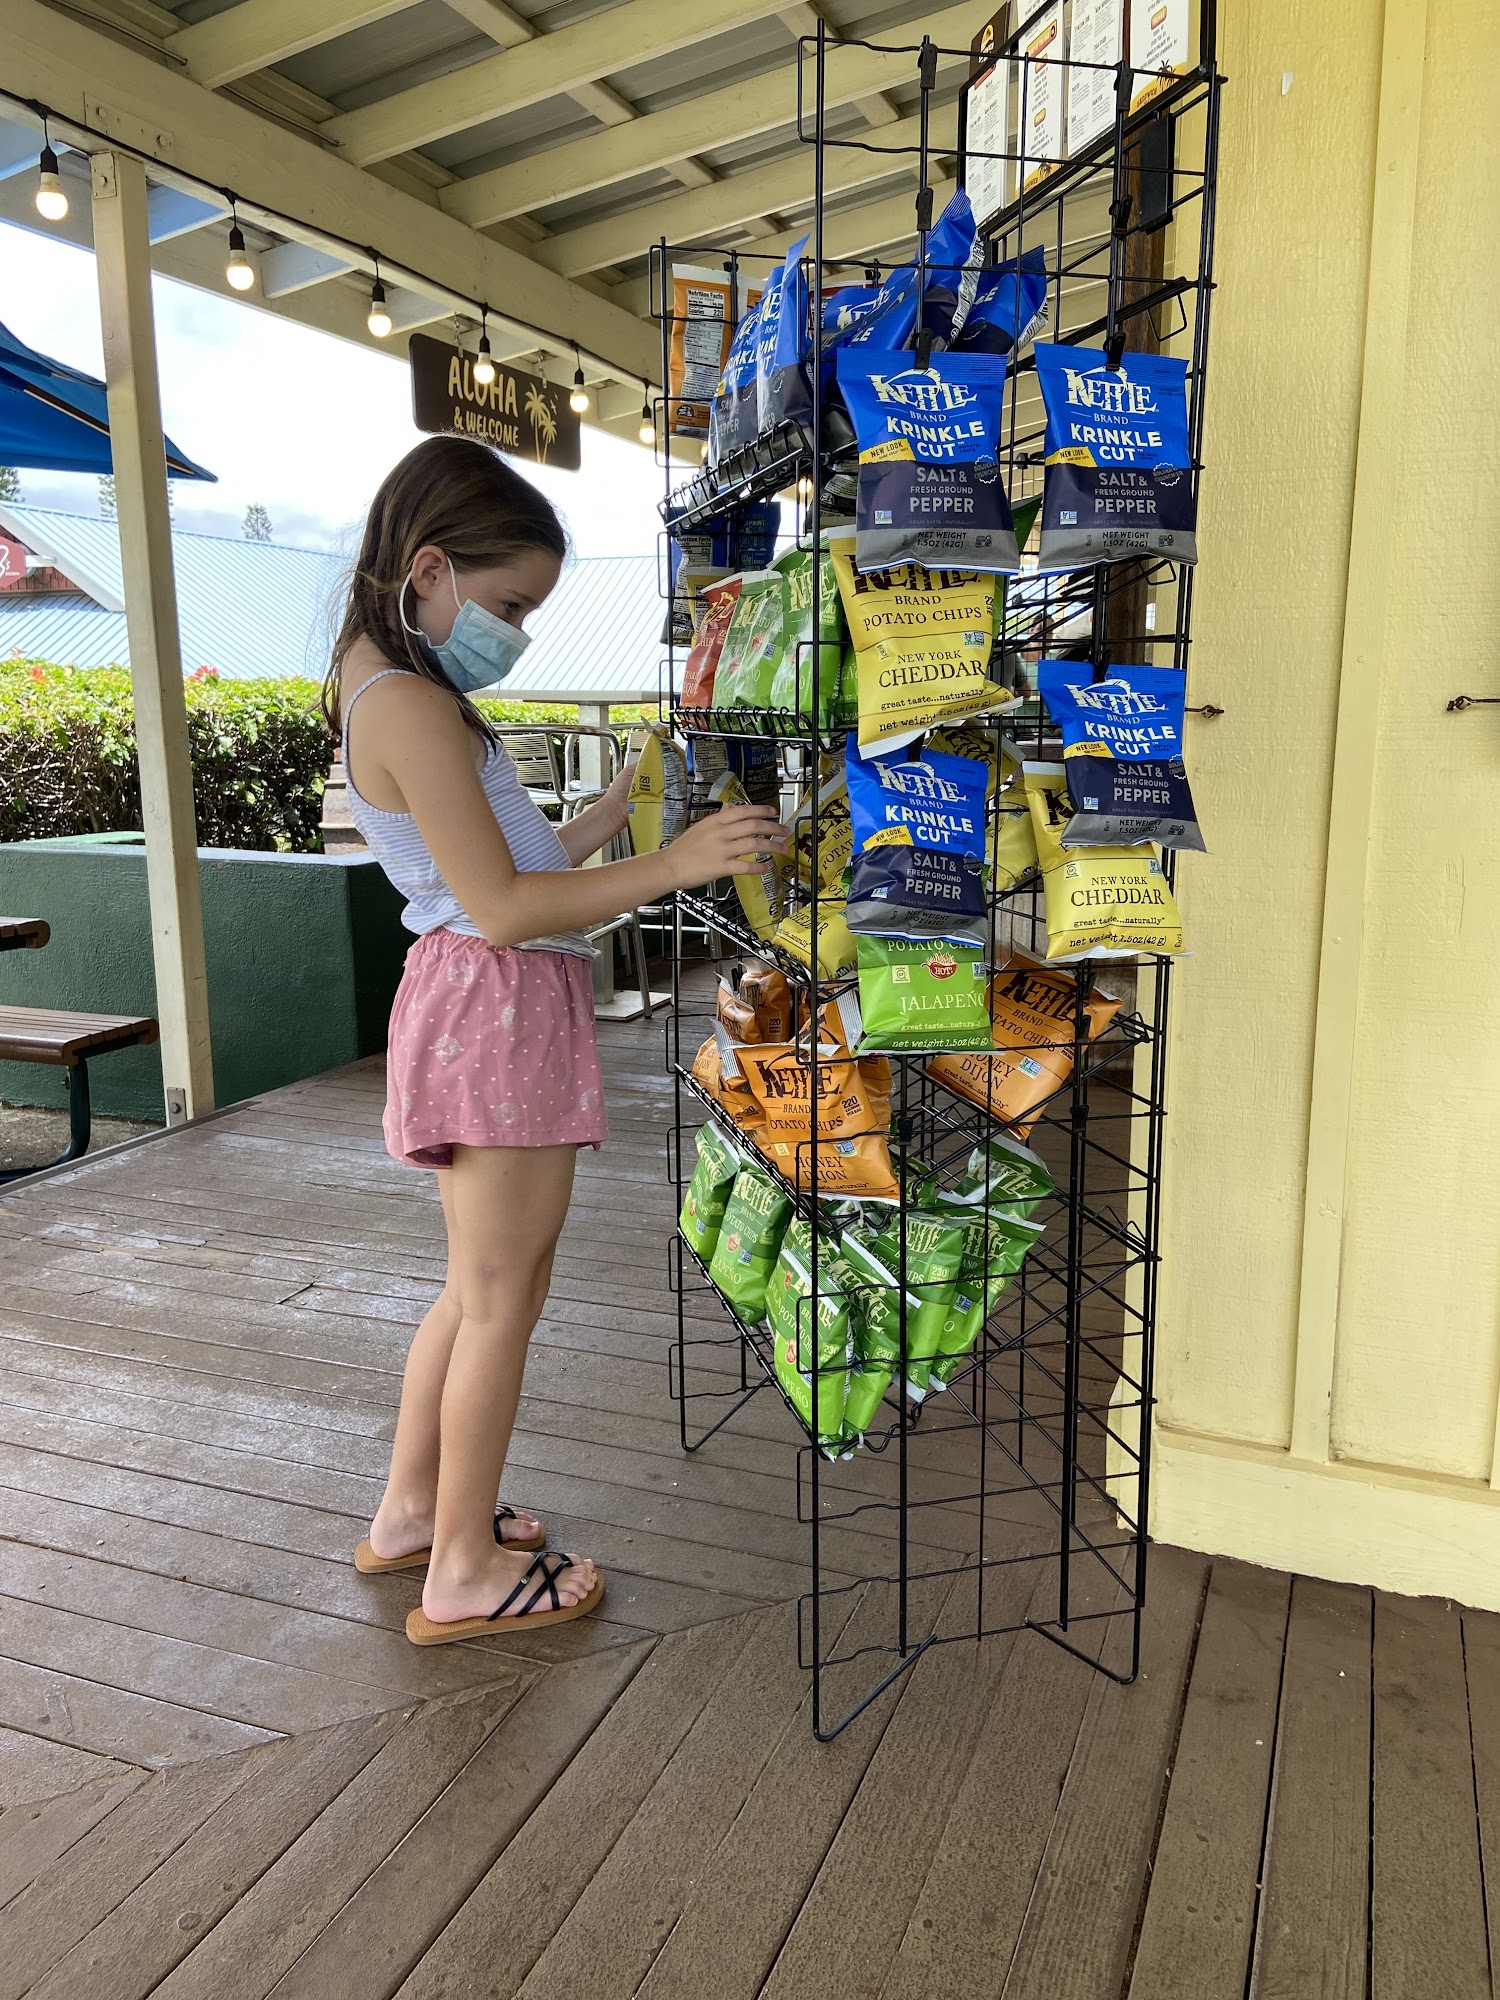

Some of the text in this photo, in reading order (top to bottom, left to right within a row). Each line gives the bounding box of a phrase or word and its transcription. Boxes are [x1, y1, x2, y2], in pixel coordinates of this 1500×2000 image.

[688, 290, 709, 298] Nutrition
[448, 356, 518, 417] ALOHA
[866, 368, 977, 411] KETTLE
[1060, 366, 1157, 415] KETTLE
[909, 410, 947, 423] BRAND
[1094, 413, 1129, 425] BRAND
[454, 406, 520, 447] & WELCOME
[887, 415, 985, 443] KRINKLE
[1070, 423, 1162, 447] KRINKLE
[870, 441, 903, 458] NEW LOOK
[917, 442, 956, 458] CUT
[1060, 450, 1071, 458] NEW
[1099, 446, 1136, 461] CUT
[917, 467, 968, 483] SALT &
[1099, 472, 1147, 487] SALT &
[910, 486, 973, 495] FRESH GROUND
[1094, 488, 1155, 497] FRESH GROUND
[910, 498, 974, 513] PEPPER
[1094, 499, 1157, 513] PEPPER
[1103, 531, 1118, 539] NET
[942, 540, 964, 548] (42G)
[895, 595, 942, 606] BRAND
[863, 607, 982, 631] POTATO CHIPS
[897, 649, 962, 664] NEW YORK
[878, 659, 986, 688] CHEDDAR
[1063, 678, 1167, 715] KETTLE
[880, 698, 905, 711] great
[879, 713, 936, 732] net weight
[1106, 714, 1141, 725] BRAND
[1084, 721, 1176, 742] KRINKLE
[1114, 741, 1150, 755] CUT
[1117, 763, 1163, 778] SALT &
[870, 761, 968, 802] KETTLE
[1113, 778, 1169, 788] FRESH GROUND
[909, 798, 943, 809] BRAND
[1113, 788, 1171, 804] PEPPER
[885, 805, 973, 833] KRINKLE
[886, 828, 902, 836] LOOK
[916, 826, 950, 844] CUT
[823, 840, 853, 870] POTAT
[914, 852, 948, 869] SALT
[949, 861, 957, 872] &
[907, 868, 962, 883] FRESH GROUND
[1091, 876, 1148, 886] NEW YORK
[905, 878, 962, 900] PEPPER
[1070, 888, 1165, 907] CHEDDAR
[922, 912, 950, 920] WEIGHT
[1073, 919, 1097, 928] great
[887, 939, 944, 952] POTATO
[1069, 938, 1086, 947] net
[934, 965, 954, 976] HOT!
[900, 990, 984, 1014] JALAPEÑO
[769, 1018, 781, 1026] 220
[1013, 1009, 1044, 1027] BRAND
[901, 1023, 922, 1031] great
[992, 1013, 1057, 1052] TATO CHIPS
[892, 1040, 909, 1048] net
[911, 1039, 944, 1049] weight
[944, 1068, 958, 1080] great
[960, 1058, 1004, 1091] DIJON
[783, 1104, 811, 1114] BRAND
[841, 1095, 858, 1108] 220
[768, 1119, 806, 1131] OTATO
[744, 1224, 759, 1243] CHIPS
[872, 1252, 900, 1276] OTATO
[961, 1258, 978, 1270] AND
[931, 1266, 948, 1278] 230
[801, 1306, 813, 1326] BRA
[823, 1344, 839, 1354] 230
[877, 1347, 893, 1359] 230
